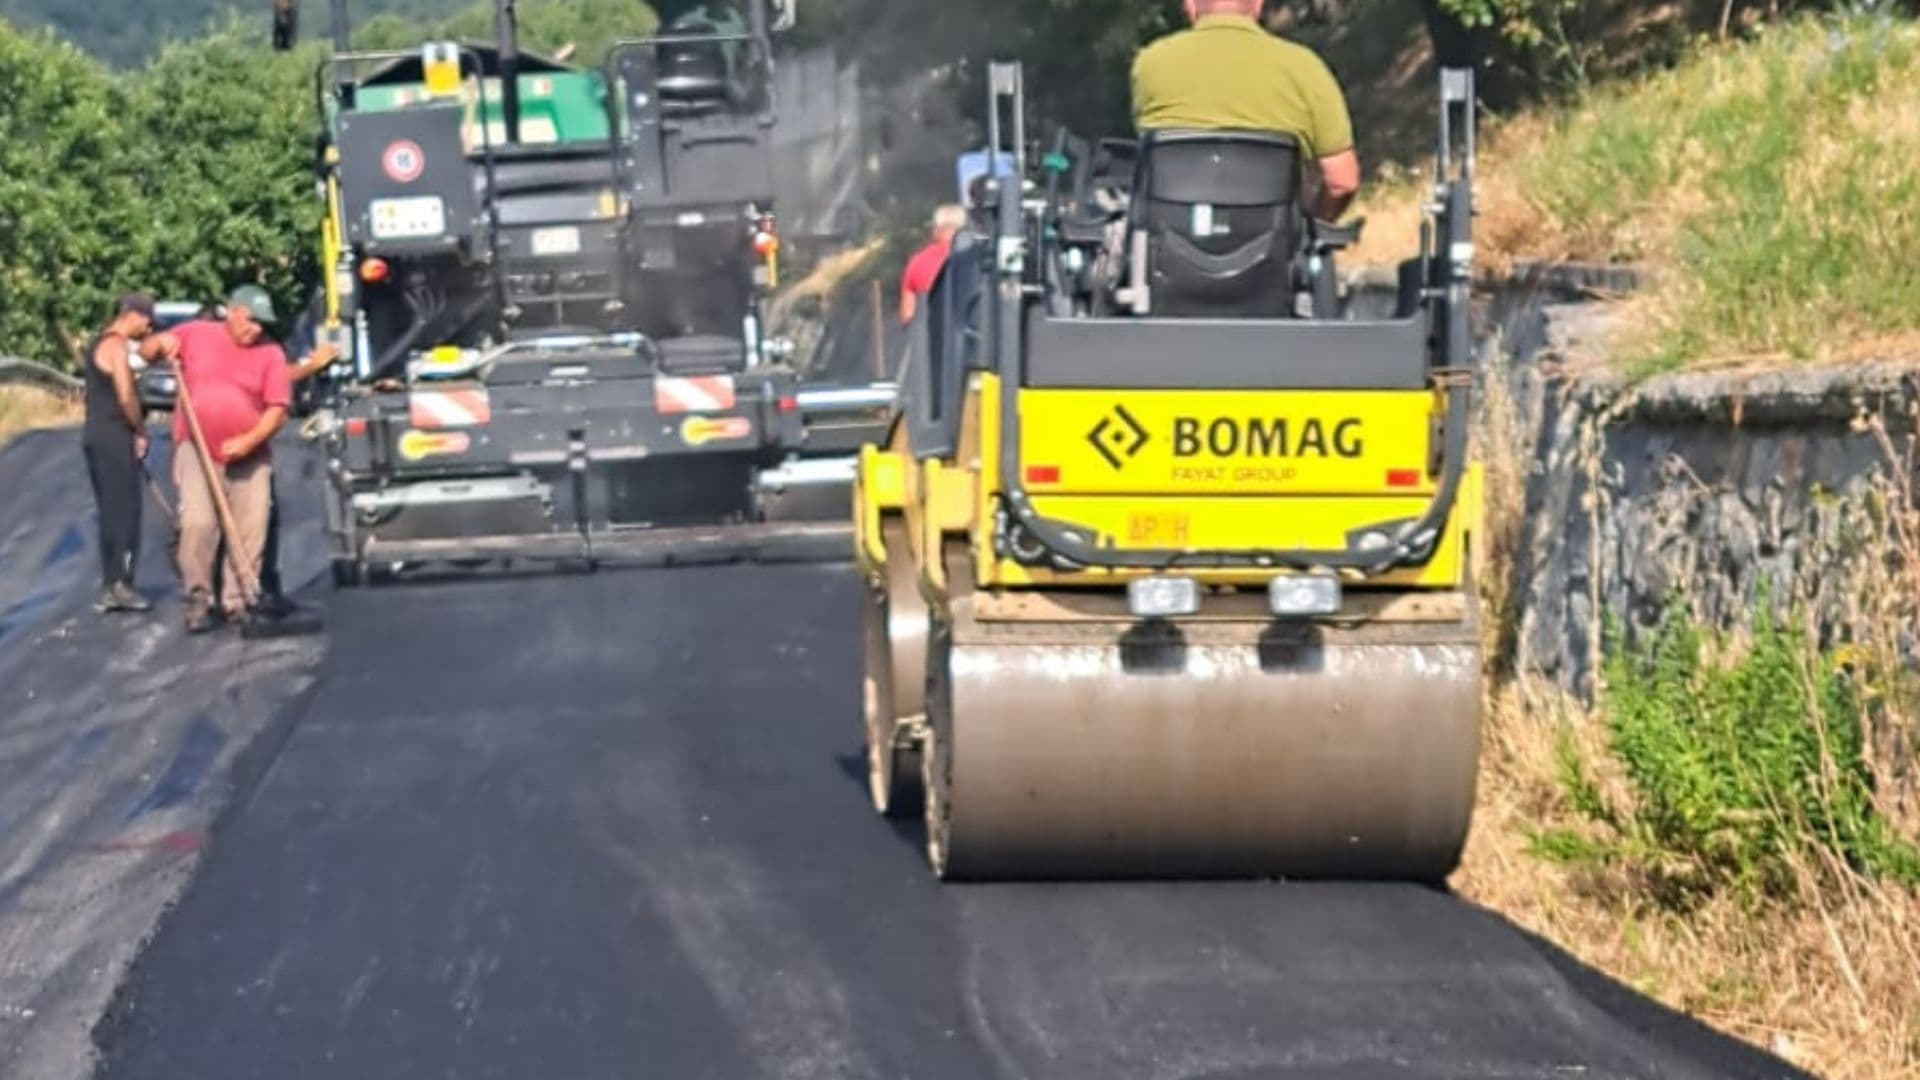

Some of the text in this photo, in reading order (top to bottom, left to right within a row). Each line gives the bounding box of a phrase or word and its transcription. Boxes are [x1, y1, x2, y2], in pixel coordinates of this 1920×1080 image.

[1173, 417, 1363, 458] BOMAG
[1172, 467, 1296, 482] FAYAT GROUP
